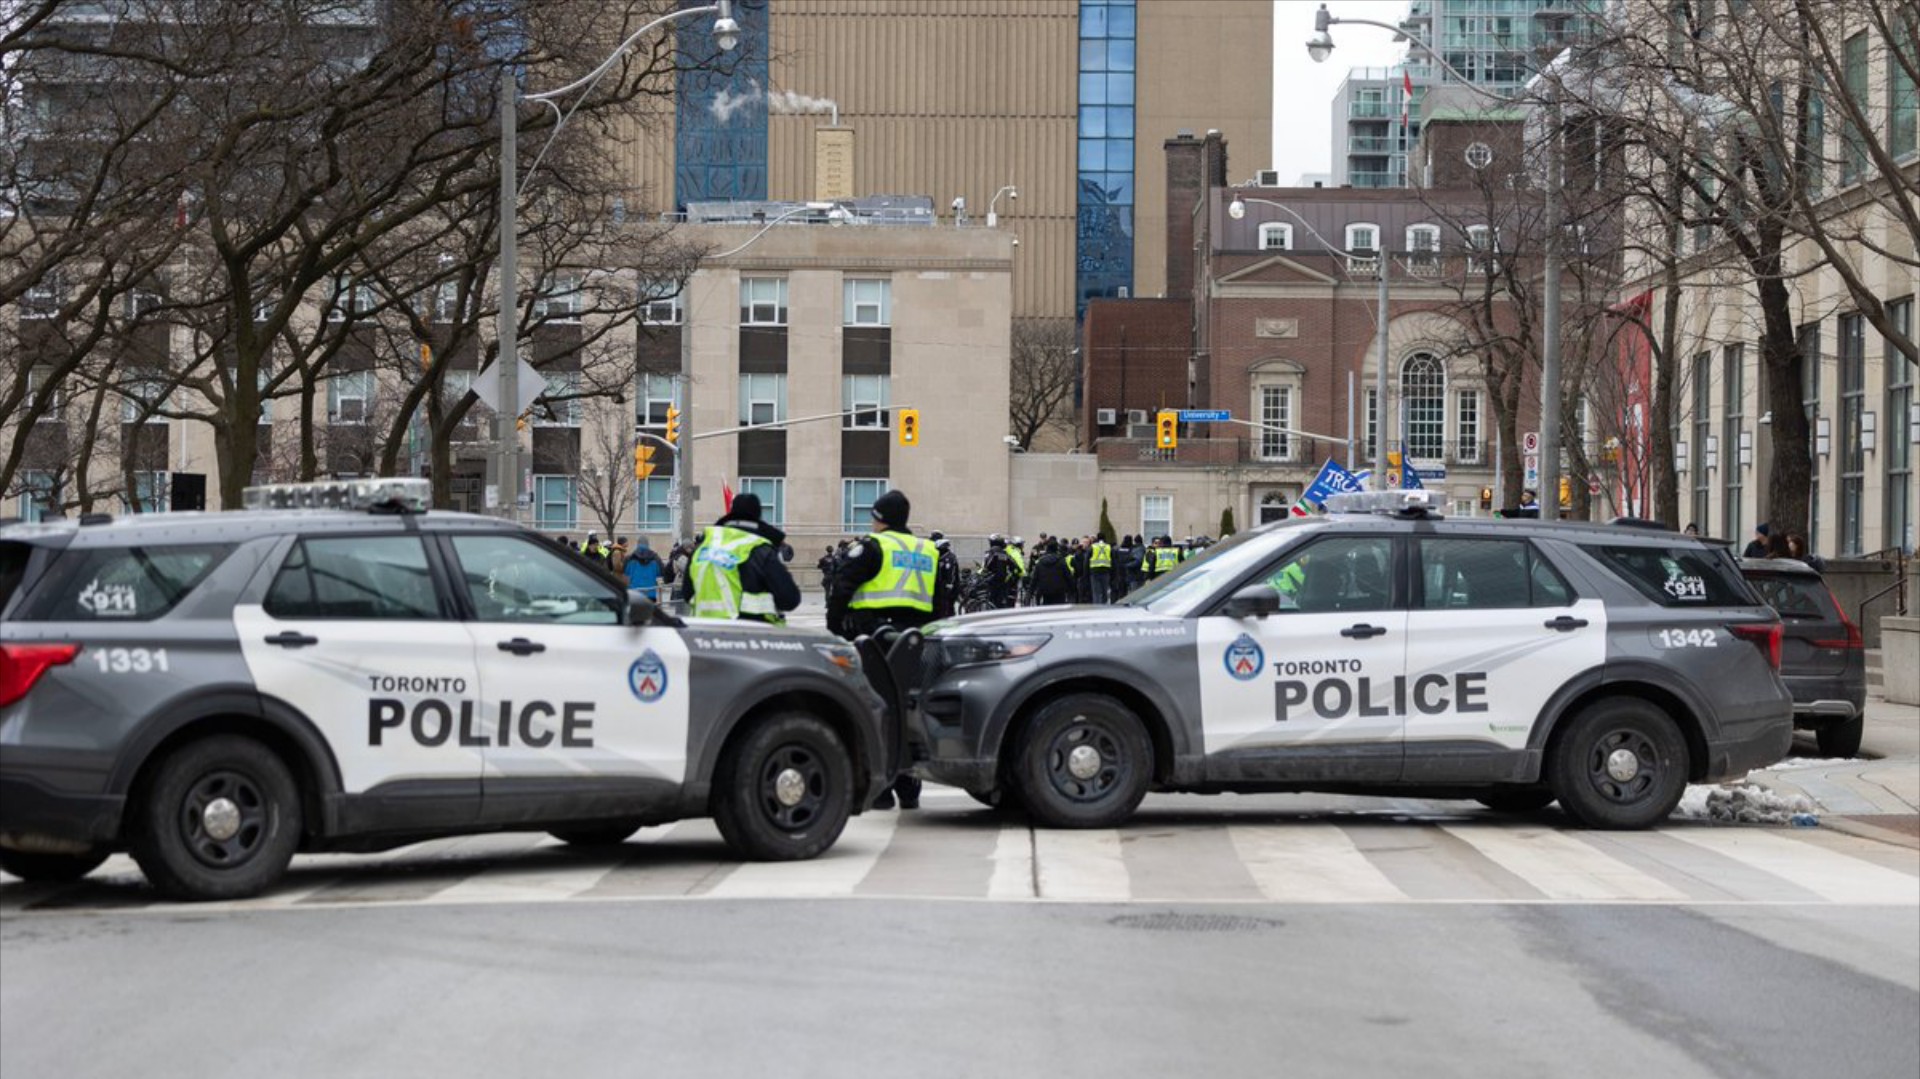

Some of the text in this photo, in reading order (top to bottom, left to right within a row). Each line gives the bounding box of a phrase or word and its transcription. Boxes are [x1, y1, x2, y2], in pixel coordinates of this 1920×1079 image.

[1183, 411, 1220, 420] University
[894, 551, 931, 571] POLICE
[1675, 582, 1706, 595] 911
[93, 591, 136, 611] 911
[1065, 630, 1082, 639] To
[1139, 625, 1186, 636] Protect
[1659, 629, 1717, 648] 1342
[694, 638, 804, 651] To Serve & Protect
[93, 647, 169, 673] 1331
[1274, 659, 1362, 676] TORONTO
[370, 676, 466, 693] TORONTO
[1275, 672, 1489, 722] POLICE
[368, 698, 596, 748] POLICE
